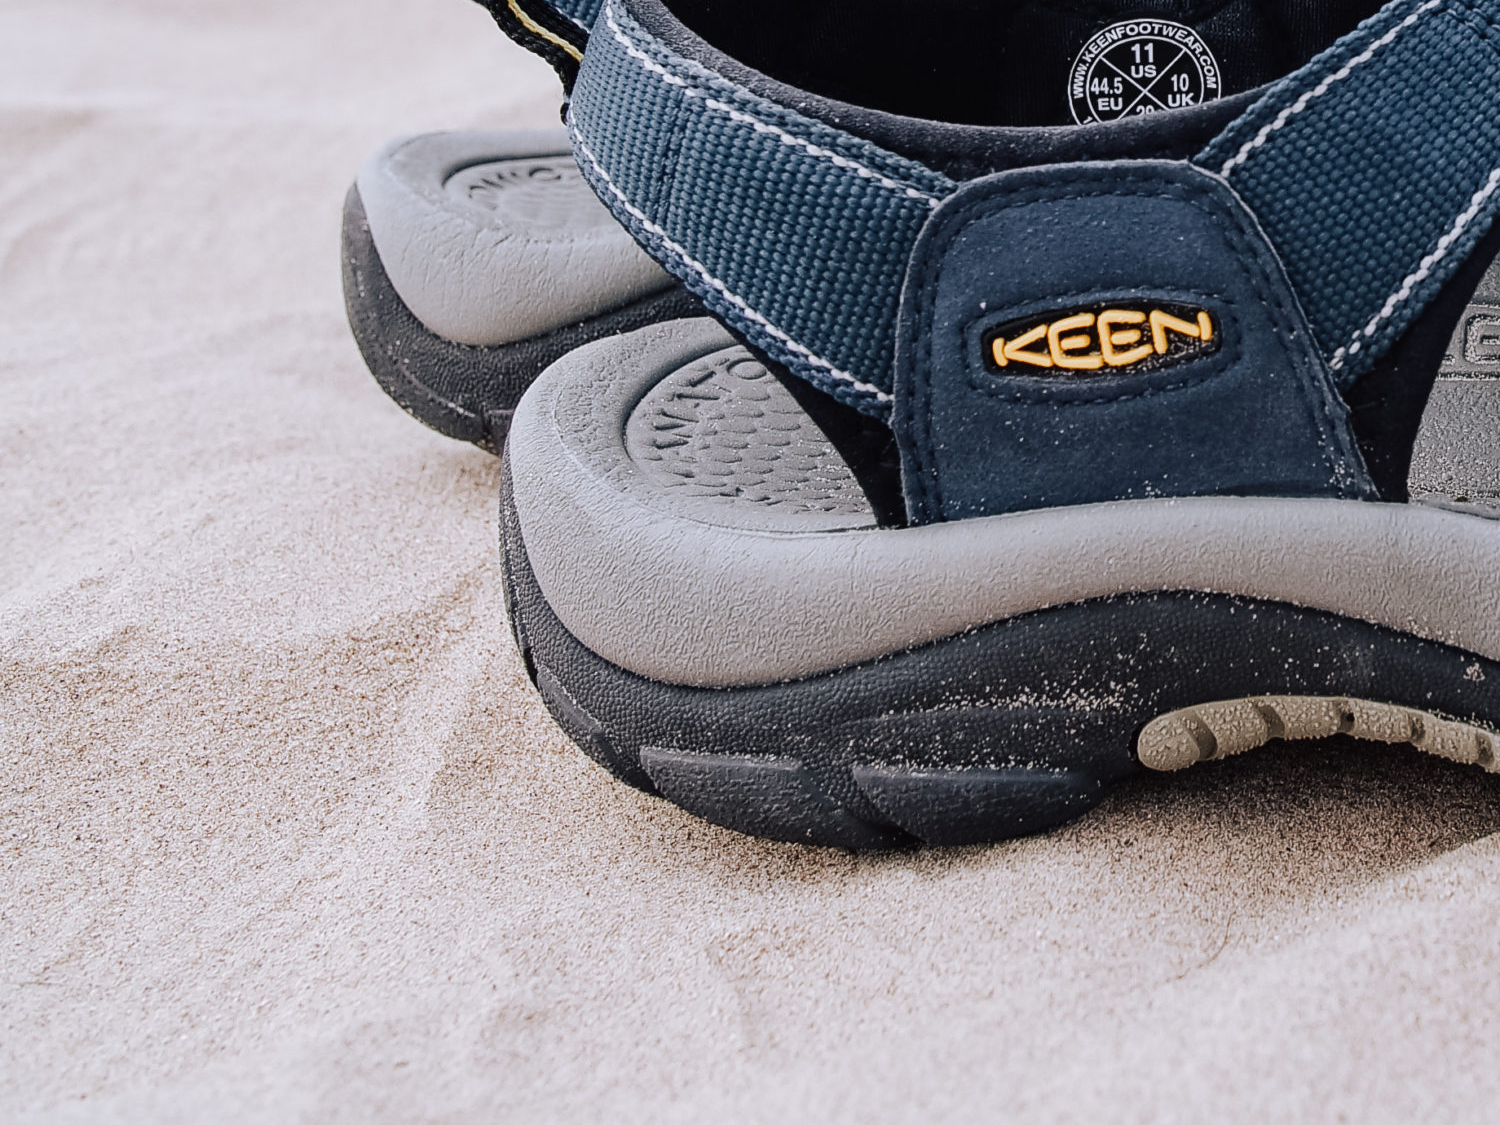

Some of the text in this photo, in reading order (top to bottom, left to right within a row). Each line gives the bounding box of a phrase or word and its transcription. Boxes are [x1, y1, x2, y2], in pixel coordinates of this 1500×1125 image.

[1072, 23, 1217, 99] WWW.KEENFOOTWEAR.COM
[1131, 43, 1154, 63] 11
[1131, 65, 1157, 78] US
[1091, 77, 1123, 95] 44.5
[1171, 73, 1189, 92] 10
[1098, 98, 1123, 111] EU
[1168, 93, 1195, 107] UK
[992, 309, 1213, 370] KEEN
